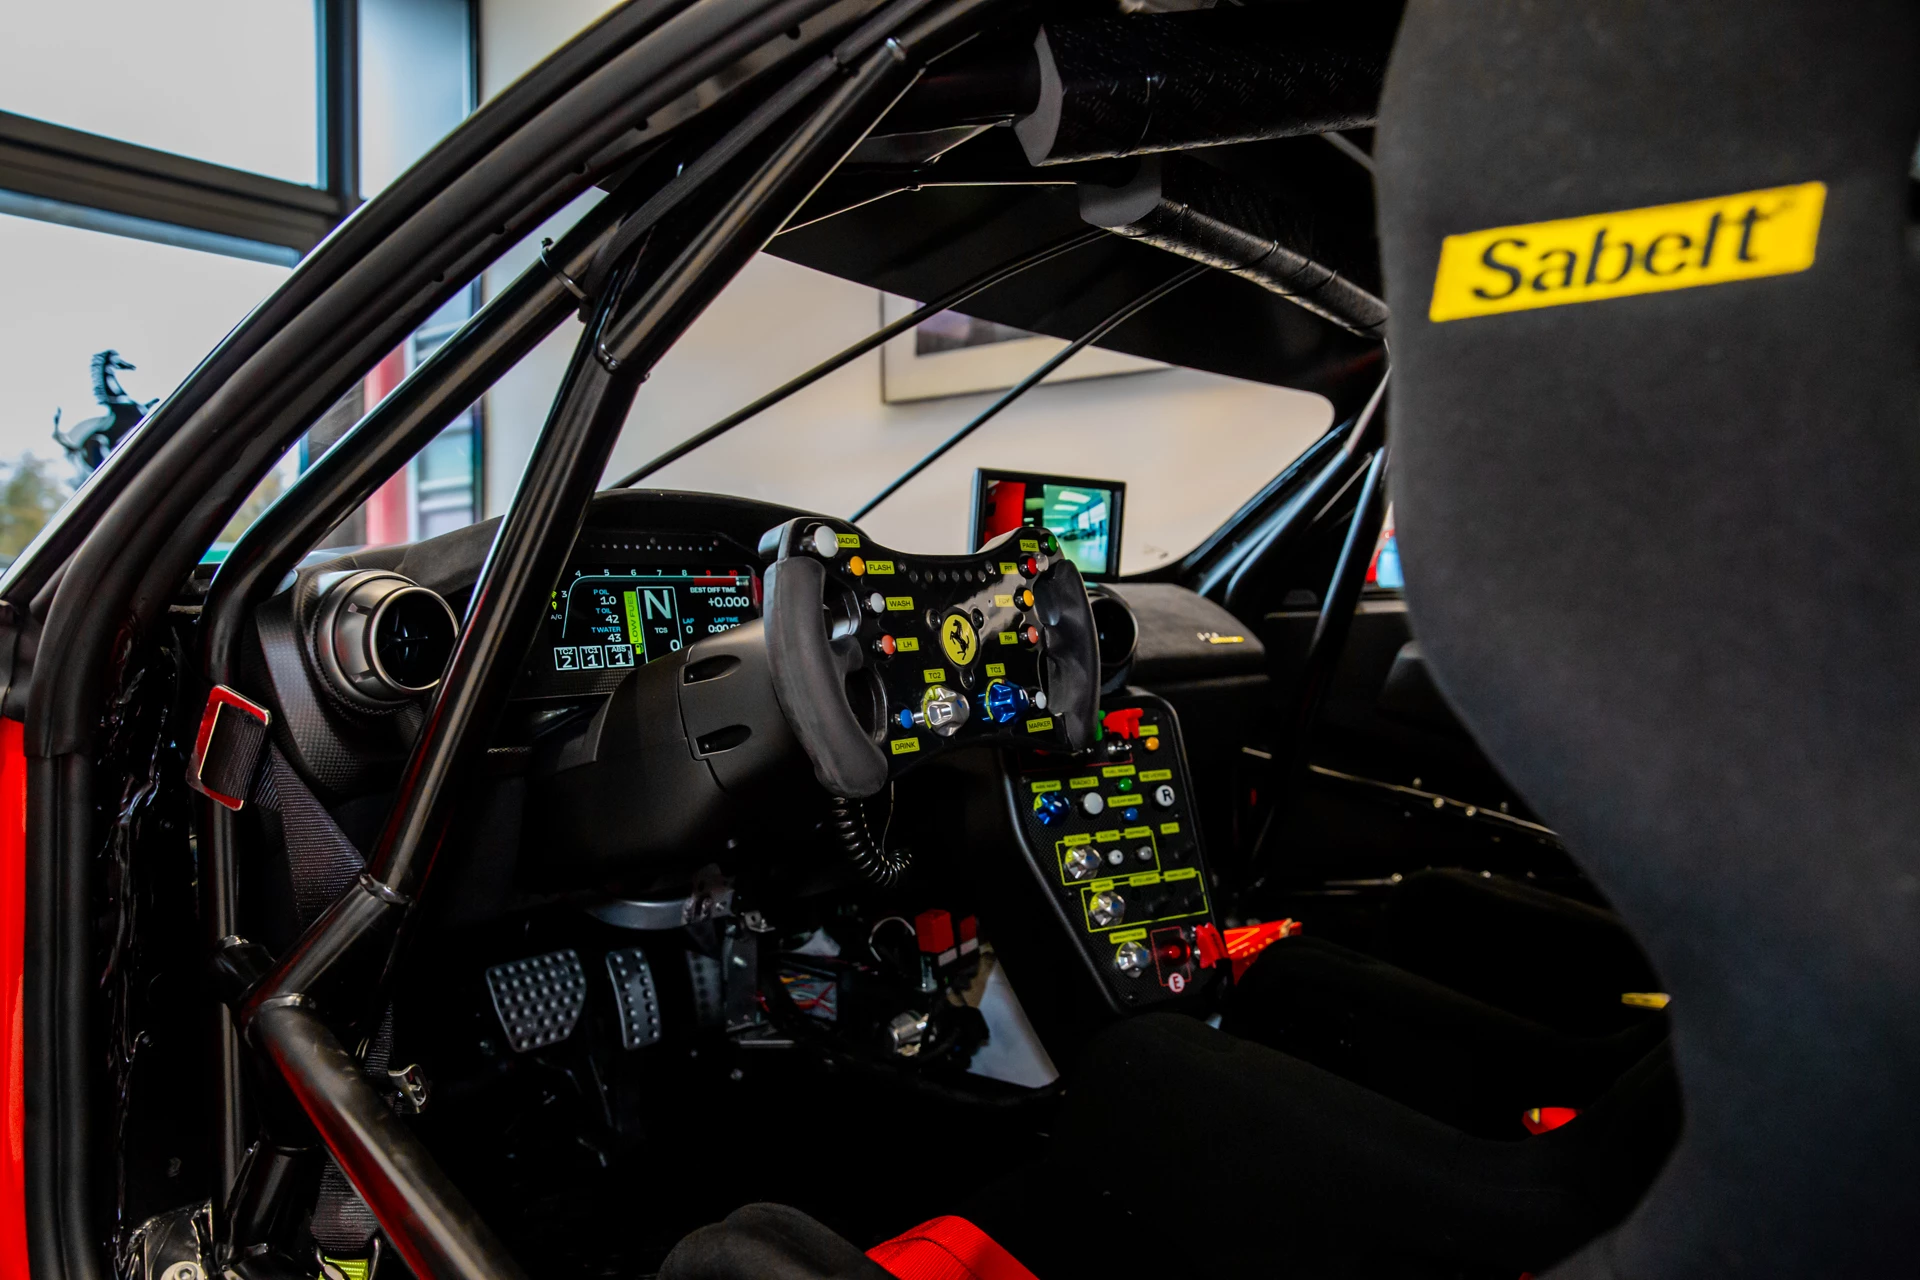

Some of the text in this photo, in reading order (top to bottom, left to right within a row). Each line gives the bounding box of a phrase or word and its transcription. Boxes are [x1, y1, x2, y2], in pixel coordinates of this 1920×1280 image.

[1472, 206, 1773, 301] Sabelt
[561, 590, 568, 598] 3
[644, 590, 672, 620] N
[708, 596, 750, 608] +0.000
[605, 615, 620, 624] 42
[627, 594, 640, 643] LOW FUEL
[686, 625, 694, 634] 0
[607, 633, 622, 643] 43
[561, 656, 573, 668] 2
[586, 655, 598, 667] 1
[614, 653, 626, 665] 1
[1028, 721, 1051, 729] MARKER
[895, 741, 916, 750] DRINK
[1162, 789, 1173, 802] R
[1173, 976, 1181, 990] E
